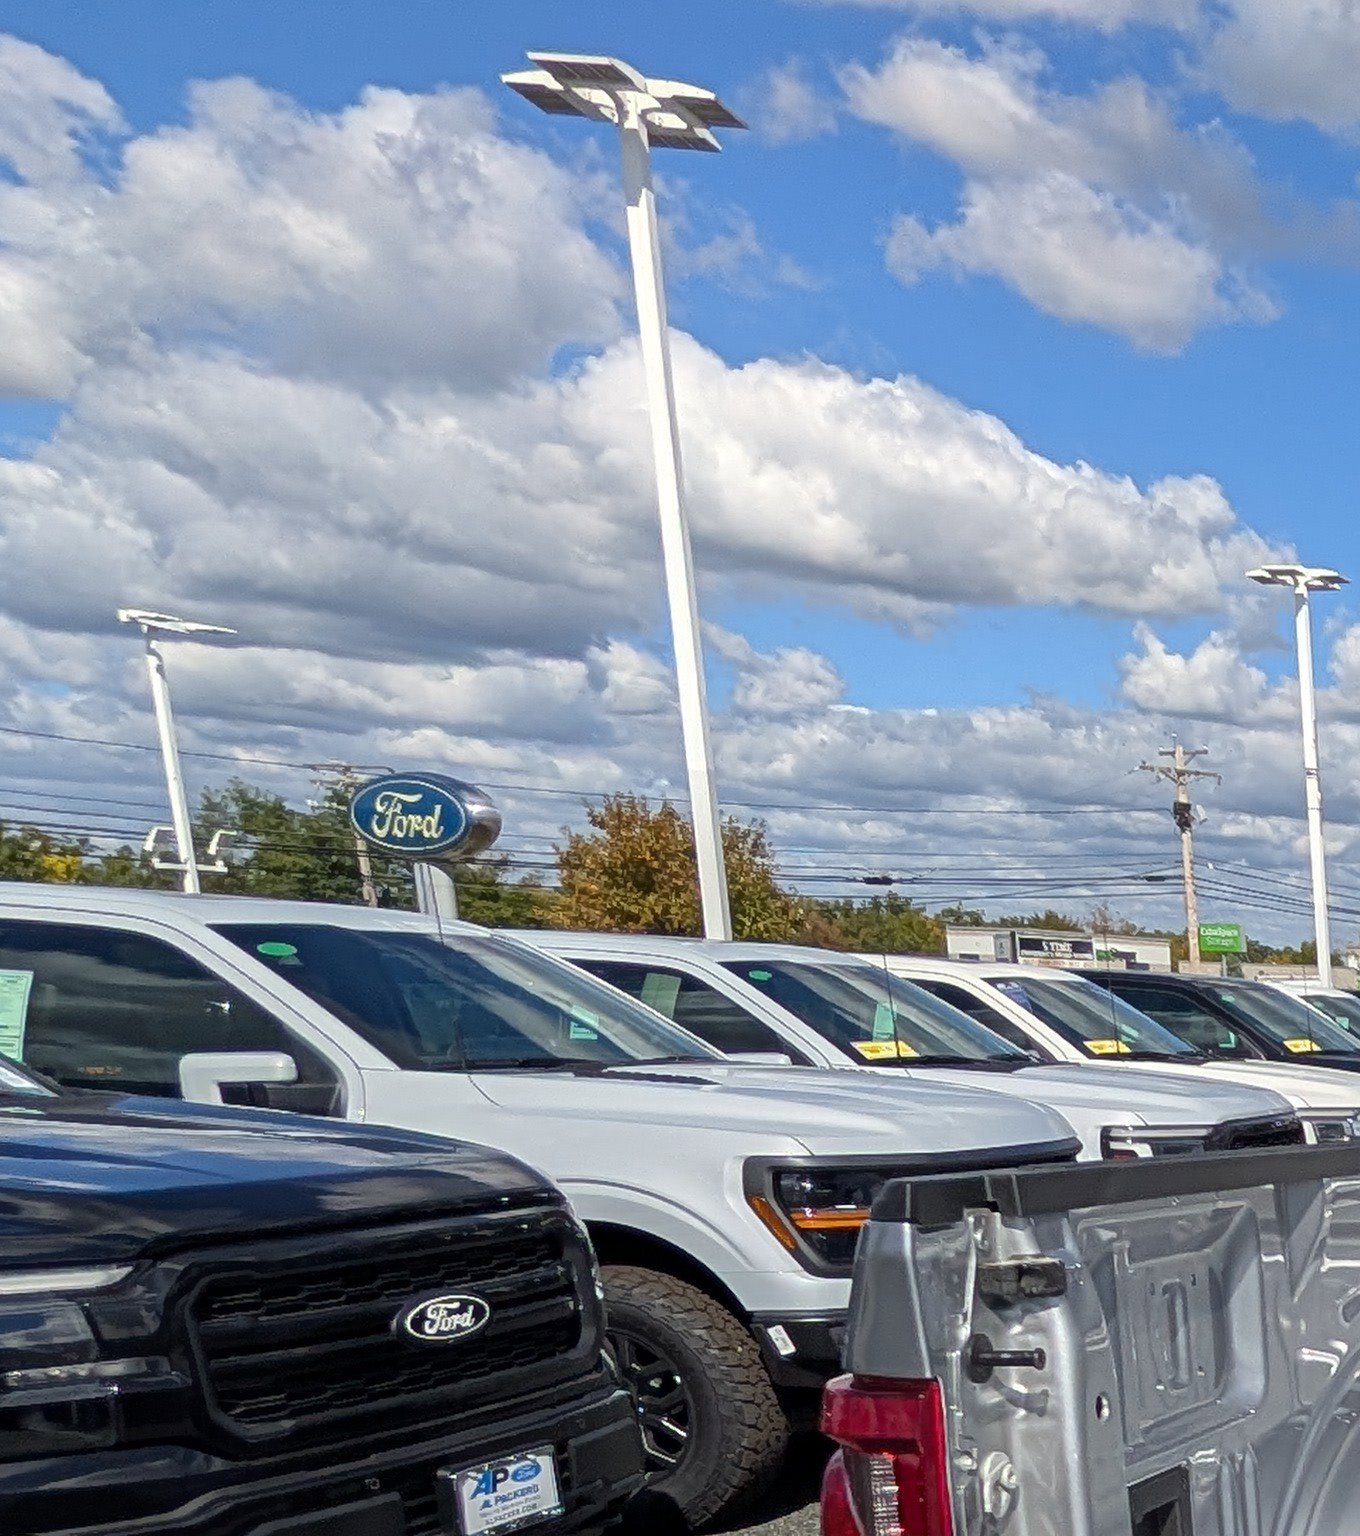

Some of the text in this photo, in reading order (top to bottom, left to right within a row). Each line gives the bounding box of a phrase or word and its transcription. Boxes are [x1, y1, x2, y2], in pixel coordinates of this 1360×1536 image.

[371, 791, 445, 839] Ford
[424, 1301, 476, 1335] Ford
[469, 1467, 510, 1500] AP
